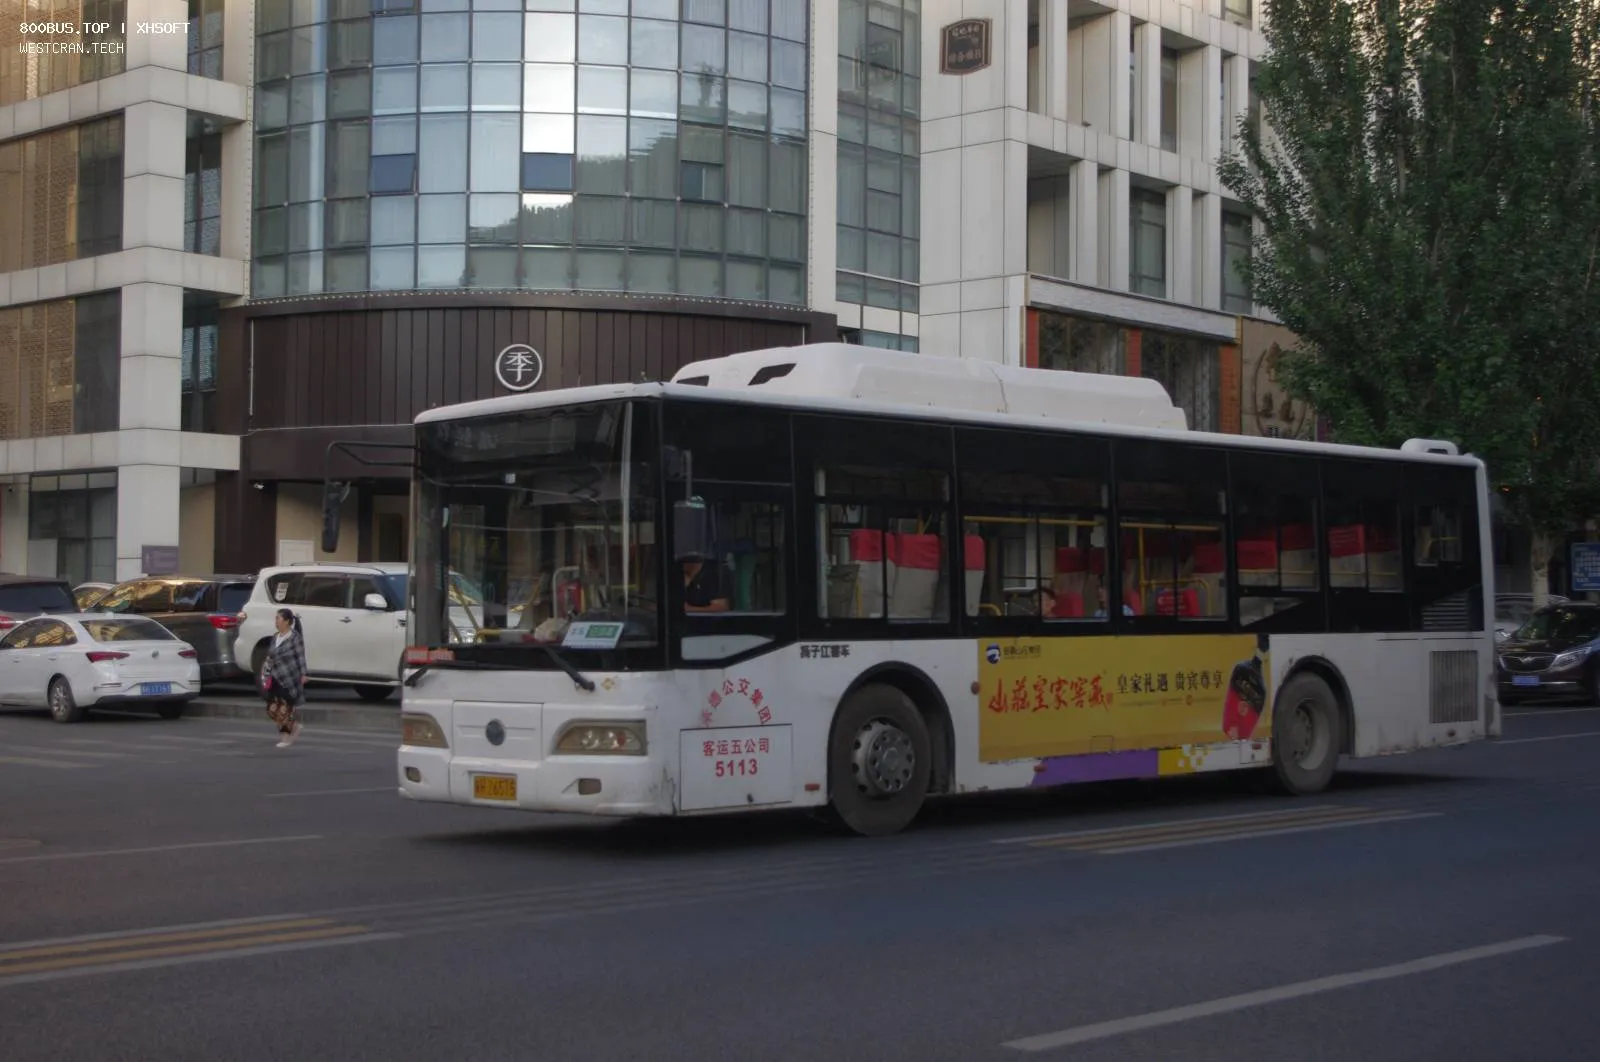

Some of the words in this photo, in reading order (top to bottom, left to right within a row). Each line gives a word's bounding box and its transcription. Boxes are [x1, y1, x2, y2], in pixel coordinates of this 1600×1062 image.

[505, 351, 534, 382] 季
[703, 737, 770, 757] 客运五公司
[715, 758, 758, 777] 5113
